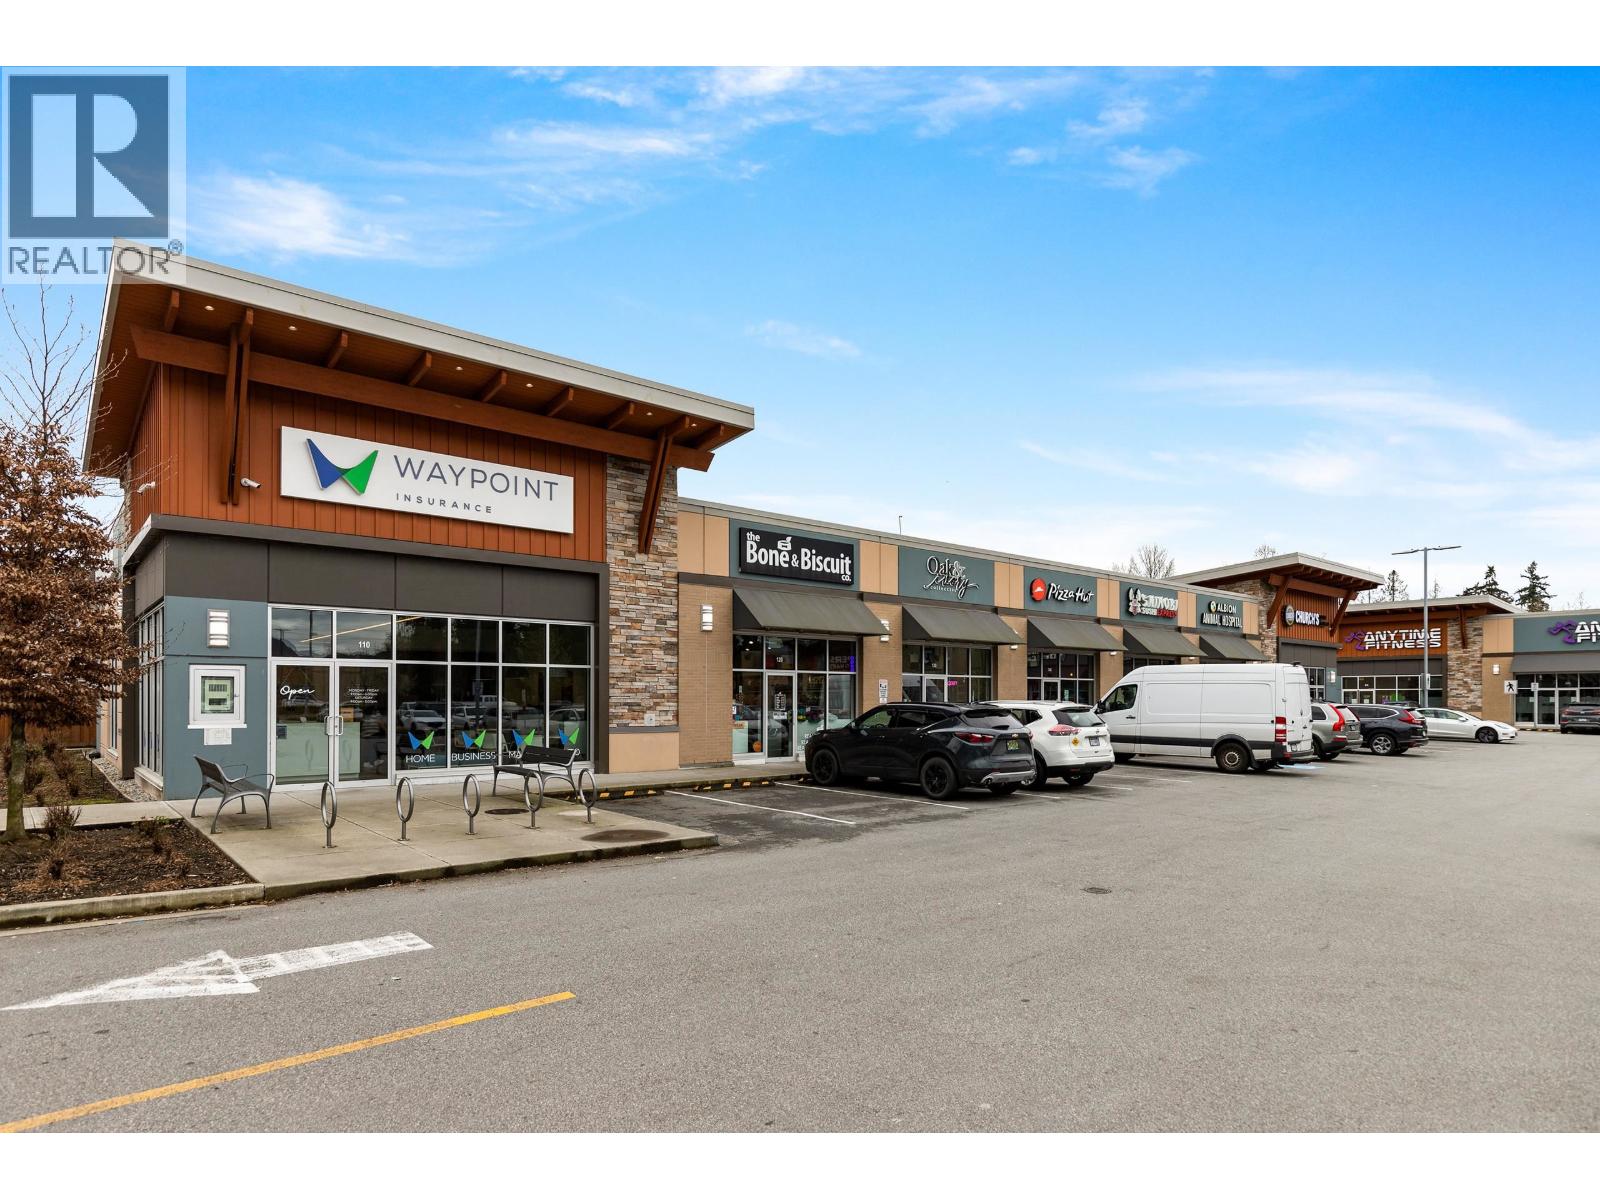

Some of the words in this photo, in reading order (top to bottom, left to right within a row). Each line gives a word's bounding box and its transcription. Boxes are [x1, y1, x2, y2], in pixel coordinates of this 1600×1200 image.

[393, 454, 559, 501] WAYPOINT
[396, 493, 492, 513] INSURANCE
[746, 531, 760, 542] the
[746, 541, 790, 567] Bone
[791, 553, 799, 567] &
[801, 548, 852, 575] Biscuit
[927, 556, 955, 576] Oak
[1047, 582, 1074, 600] Pizza
[1075, 587, 1094, 602] Hut
[1217, 603, 1237, 614] ALBION
[1202, 612, 1221, 626] ANIMAL
[1222, 615, 1242, 628] HOSPITAL
[1364, 628, 1441, 641] ANYTIME
[358, 640, 371, 649] 110
[1365, 639, 1441, 650] FITNESS
[280, 685, 316, 700] Open
[405, 753, 435, 763] HOME
[451, 751, 497, 761] BUSINESS
